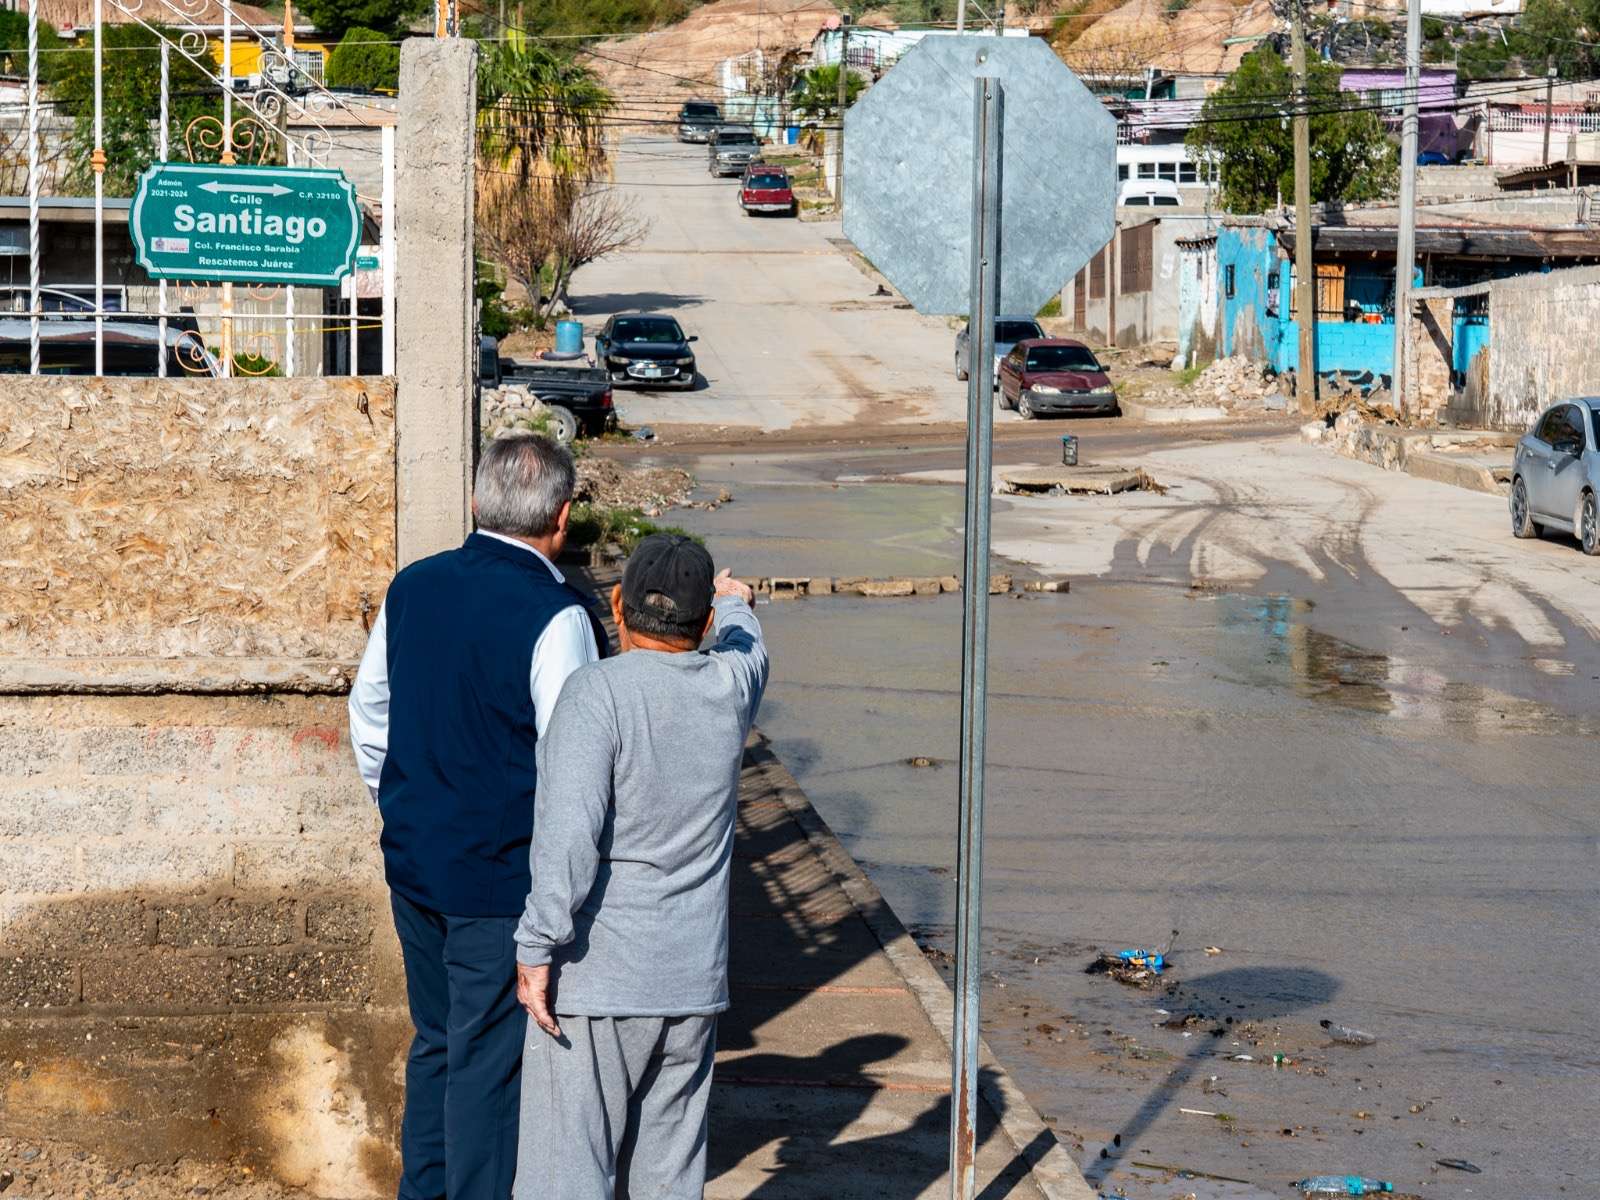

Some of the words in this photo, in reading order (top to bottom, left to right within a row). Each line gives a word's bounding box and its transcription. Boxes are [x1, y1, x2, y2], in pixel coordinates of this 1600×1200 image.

[158, 179, 183, 187] Admón
[151, 189, 189, 198] 2021-2024
[230, 194, 263, 205] Calle
[173, 204, 327, 244] Santiago
[195, 241, 213, 250] Col.
[215, 242, 262, 252] Francisco
[264, 244, 300, 254] Sarabia
[198, 256, 259, 267] Rescatemos
[261, 259, 294, 269] Juárez
